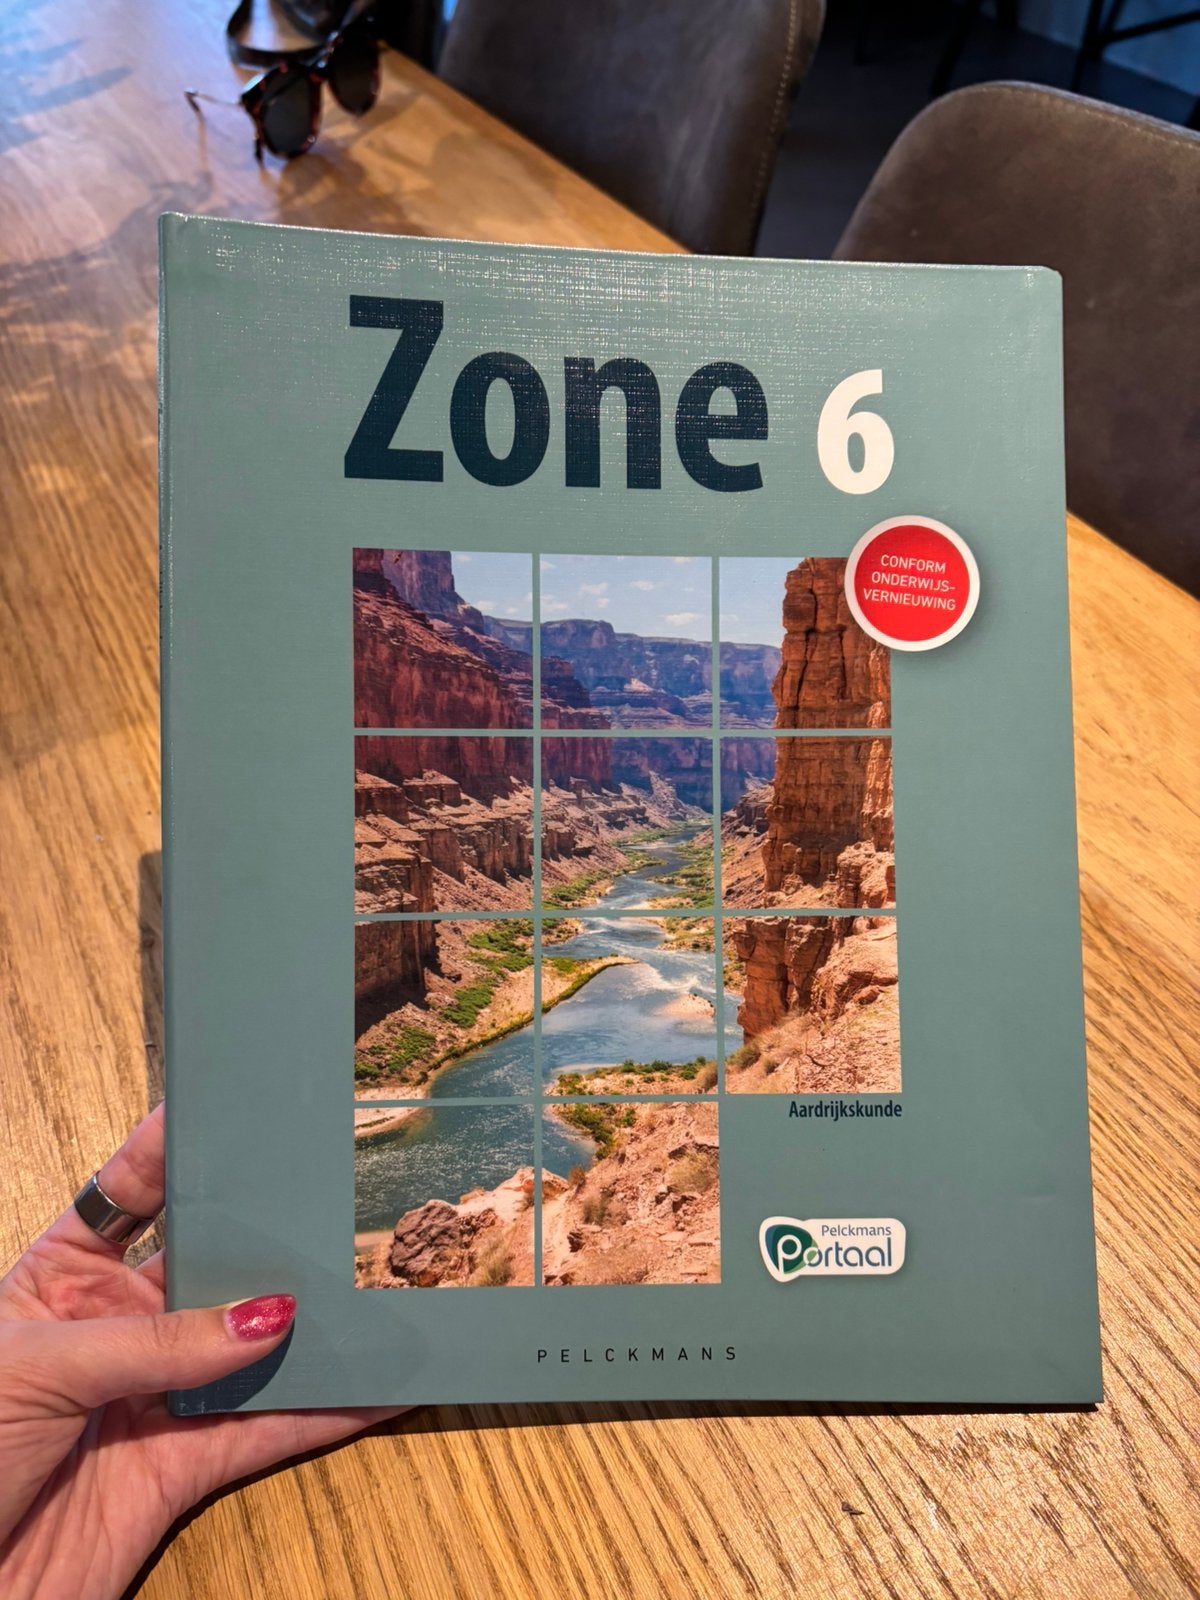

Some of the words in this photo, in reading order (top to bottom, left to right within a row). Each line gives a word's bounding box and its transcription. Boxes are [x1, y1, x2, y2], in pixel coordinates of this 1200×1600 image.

[344, 294, 769, 493] Zone
[816, 368, 896, 496] 6
[880, 554, 947, 574] CONFORM
[871, 571, 956, 592] ONDERWIJS-
[863, 588, 956, 611] VERNIEUWING
[789, 1100, 903, 1122] Aardrijkskunde
[821, 1224, 892, 1237] Pelckmans
[537, 1347, 736, 1364] PELCKMANS
